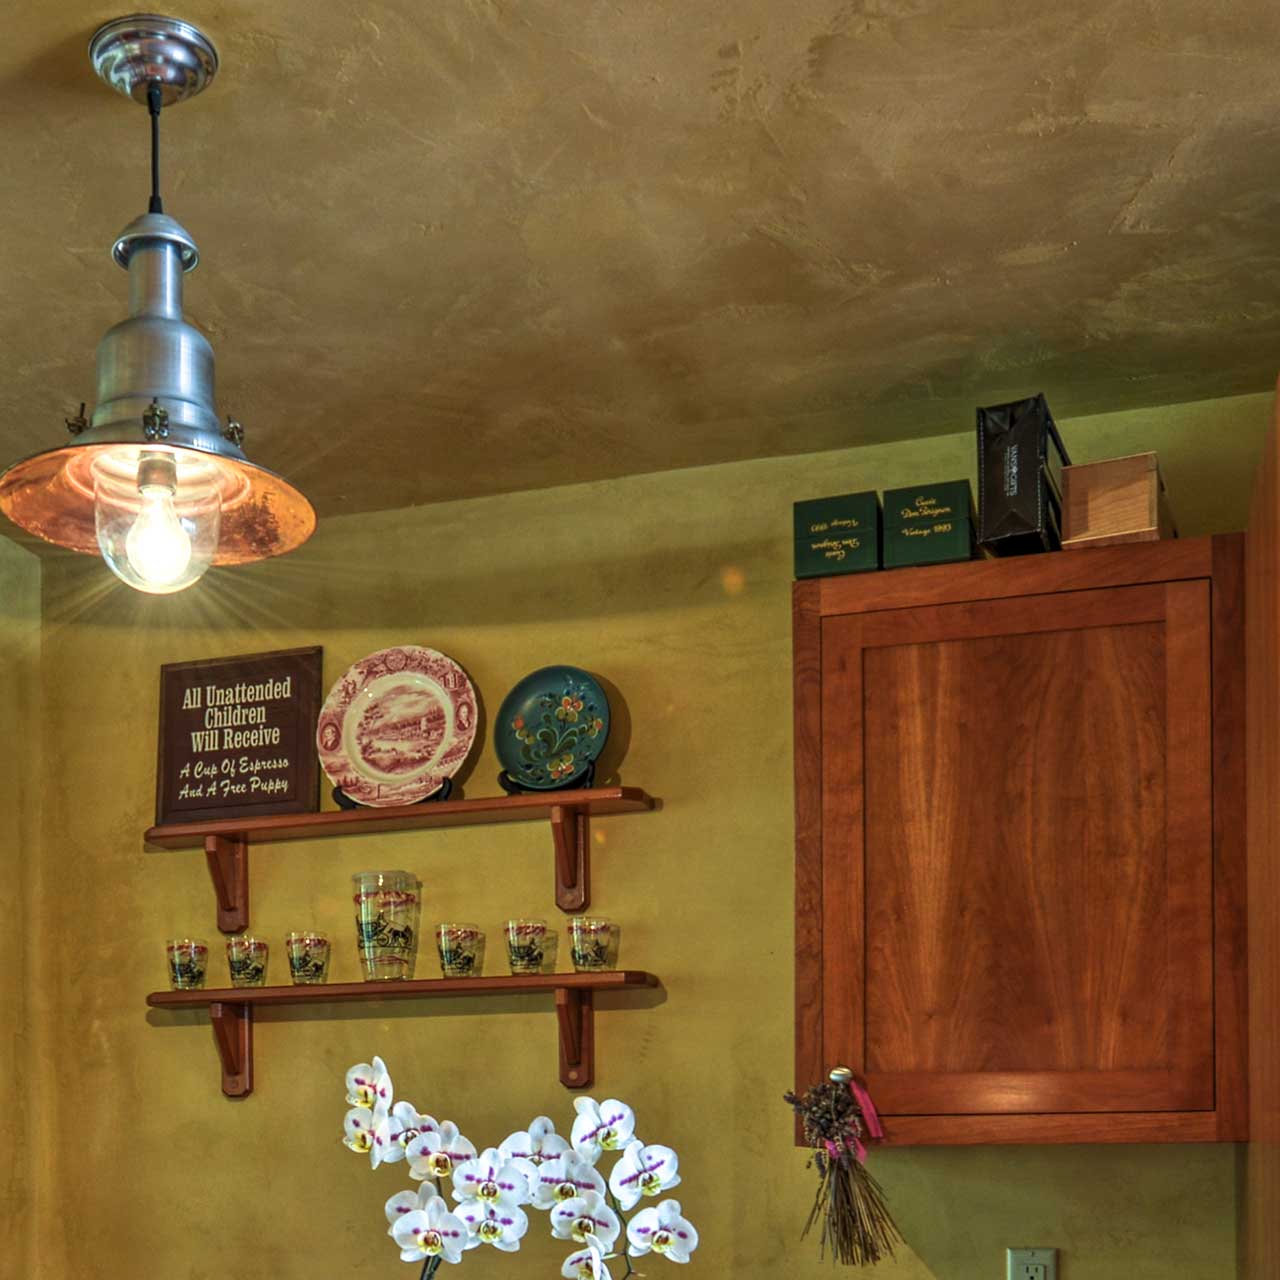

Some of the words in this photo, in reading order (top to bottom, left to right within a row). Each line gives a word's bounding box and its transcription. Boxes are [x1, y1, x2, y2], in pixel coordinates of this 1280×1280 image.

[182, 687, 201, 709] All
[206, 676, 291, 706] Unattended
[205, 705, 266, 729] Children
[191, 729, 219, 753] Will
[223, 725, 280, 750] Receive
[179, 762, 190, 779] A
[194, 761, 218, 778] Cup
[221, 758, 236, 778] Of
[239, 756, 289, 775] Espresso
[178, 784, 203, 800] And
[206, 781, 217, 797] A
[220, 779, 247, 797] Free
[249, 776, 289, 795] Puppy
